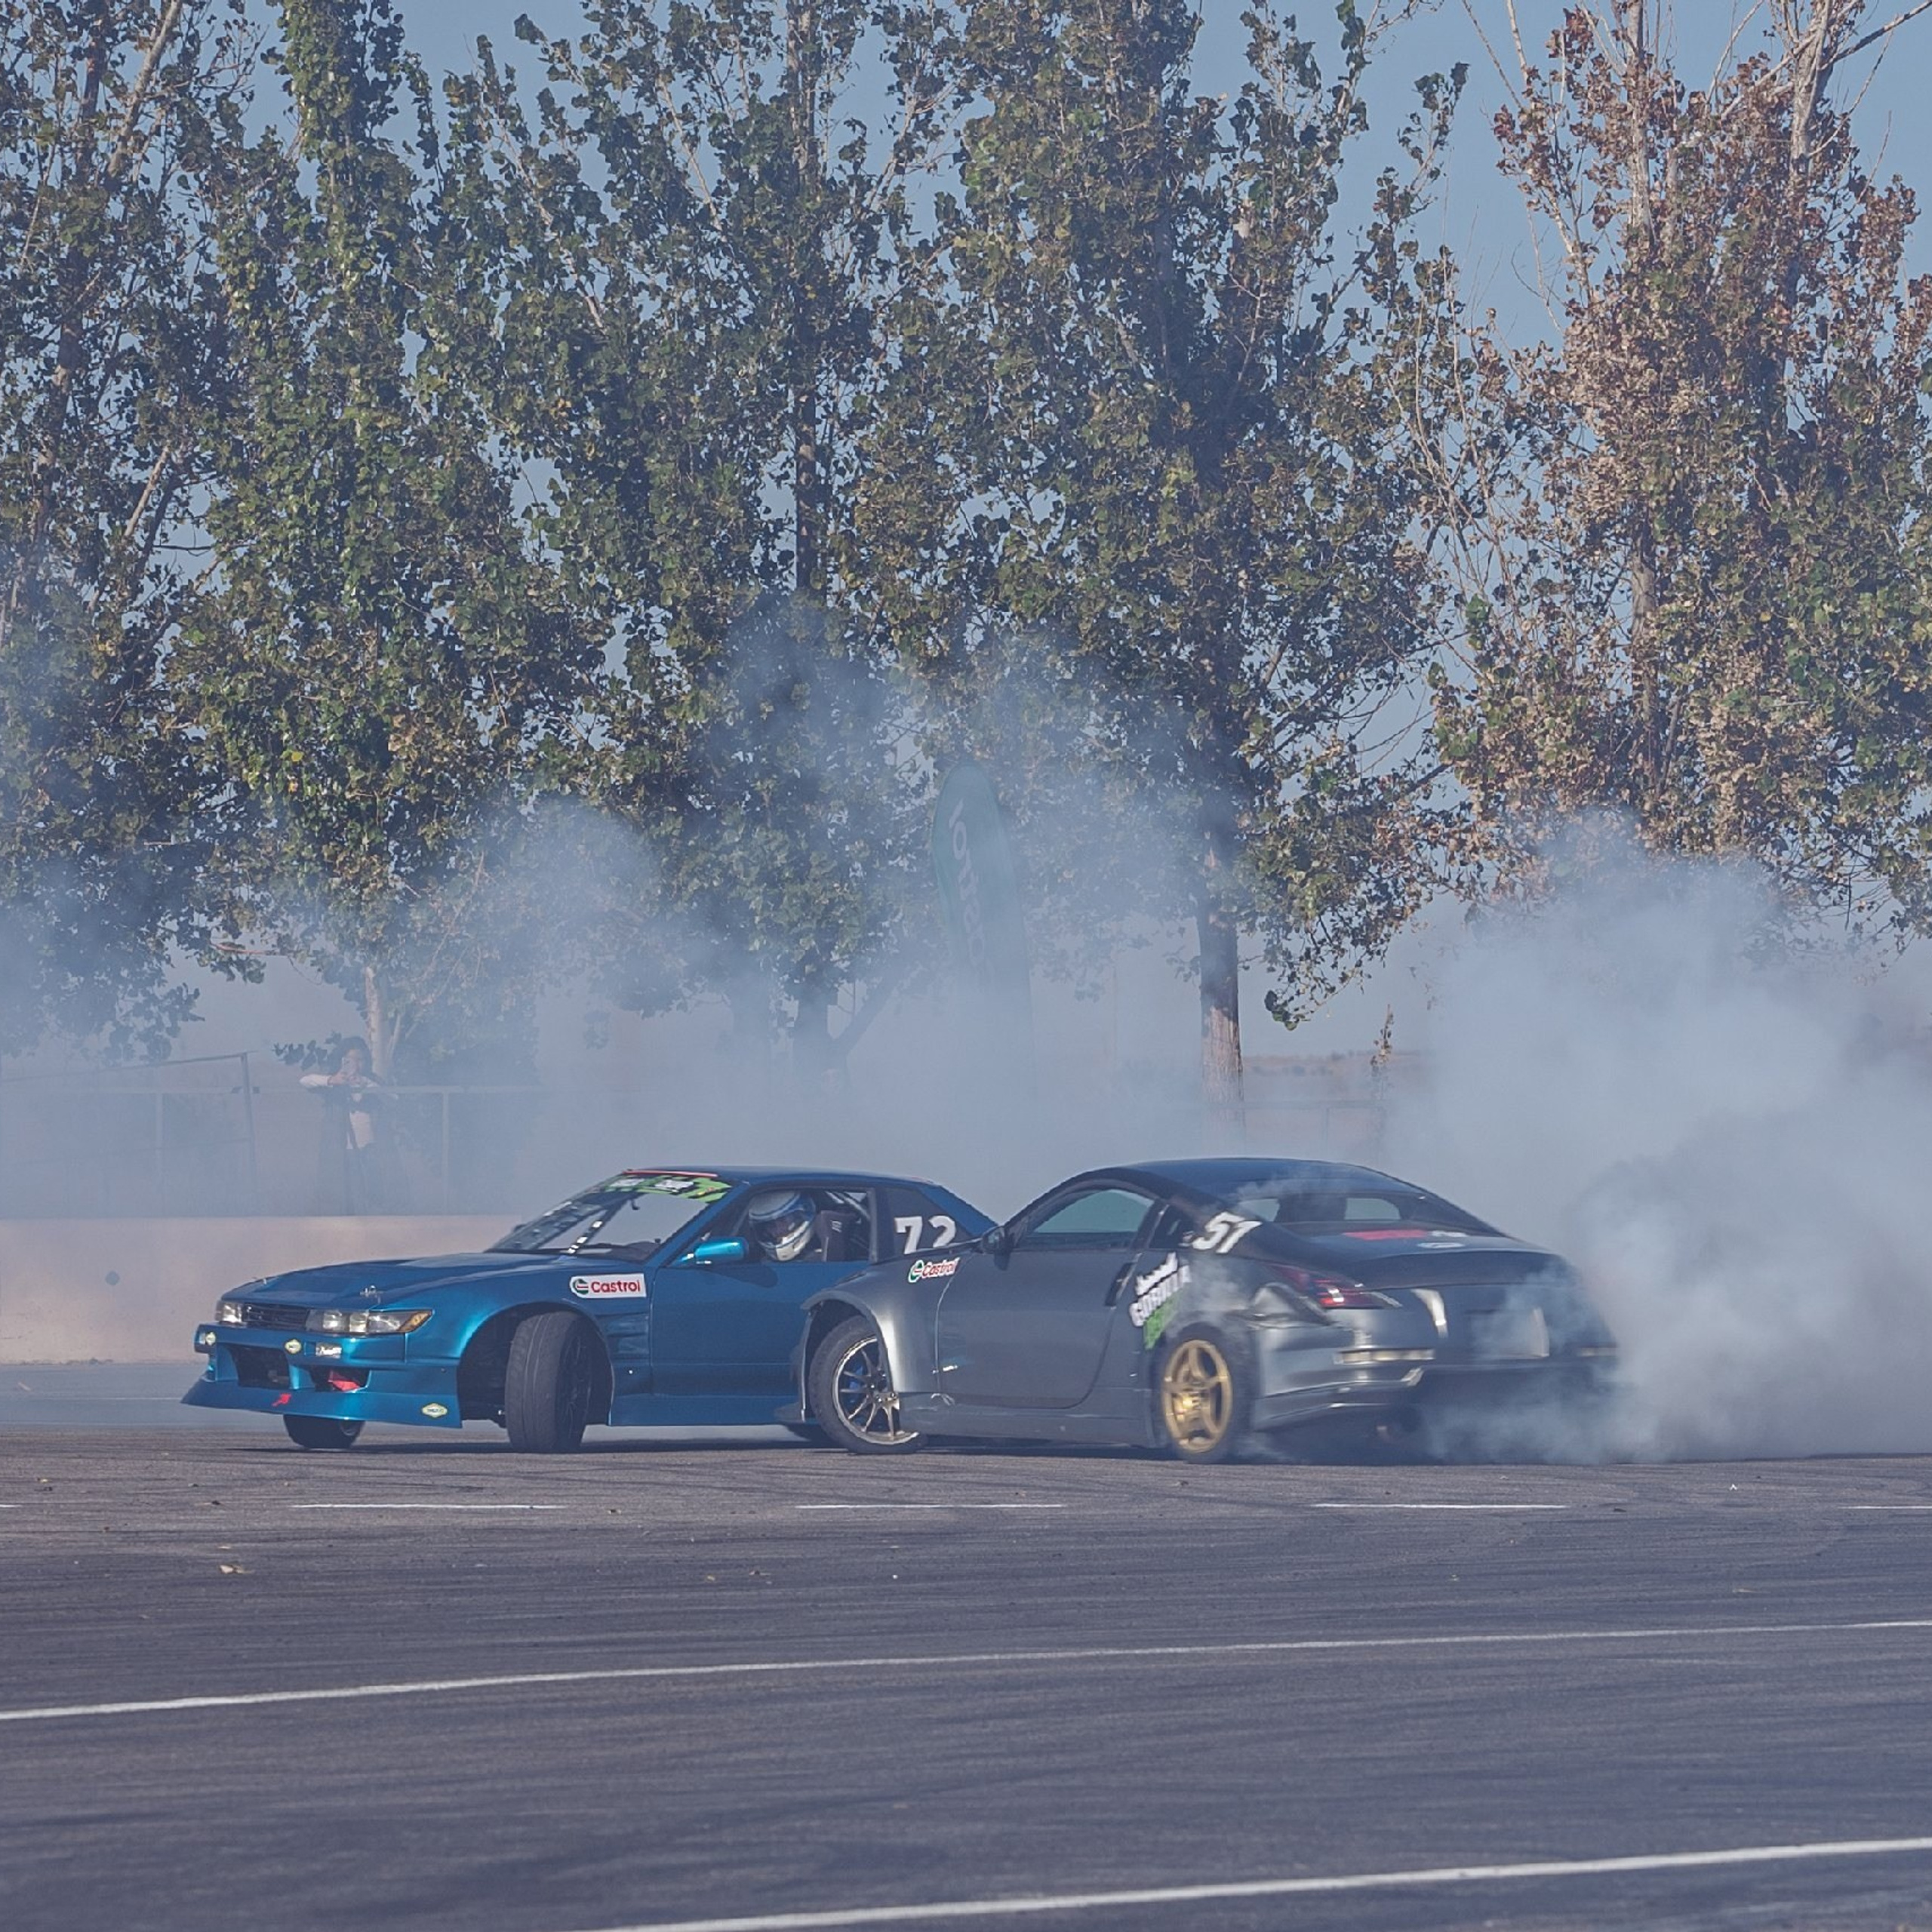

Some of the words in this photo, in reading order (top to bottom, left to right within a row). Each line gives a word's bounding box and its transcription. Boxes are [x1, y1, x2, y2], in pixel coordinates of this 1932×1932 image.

[894, 1215, 956, 1254] 72
[922, 1258, 958, 1278] Castrol
[591, 1280, 641, 1293] Castrol
